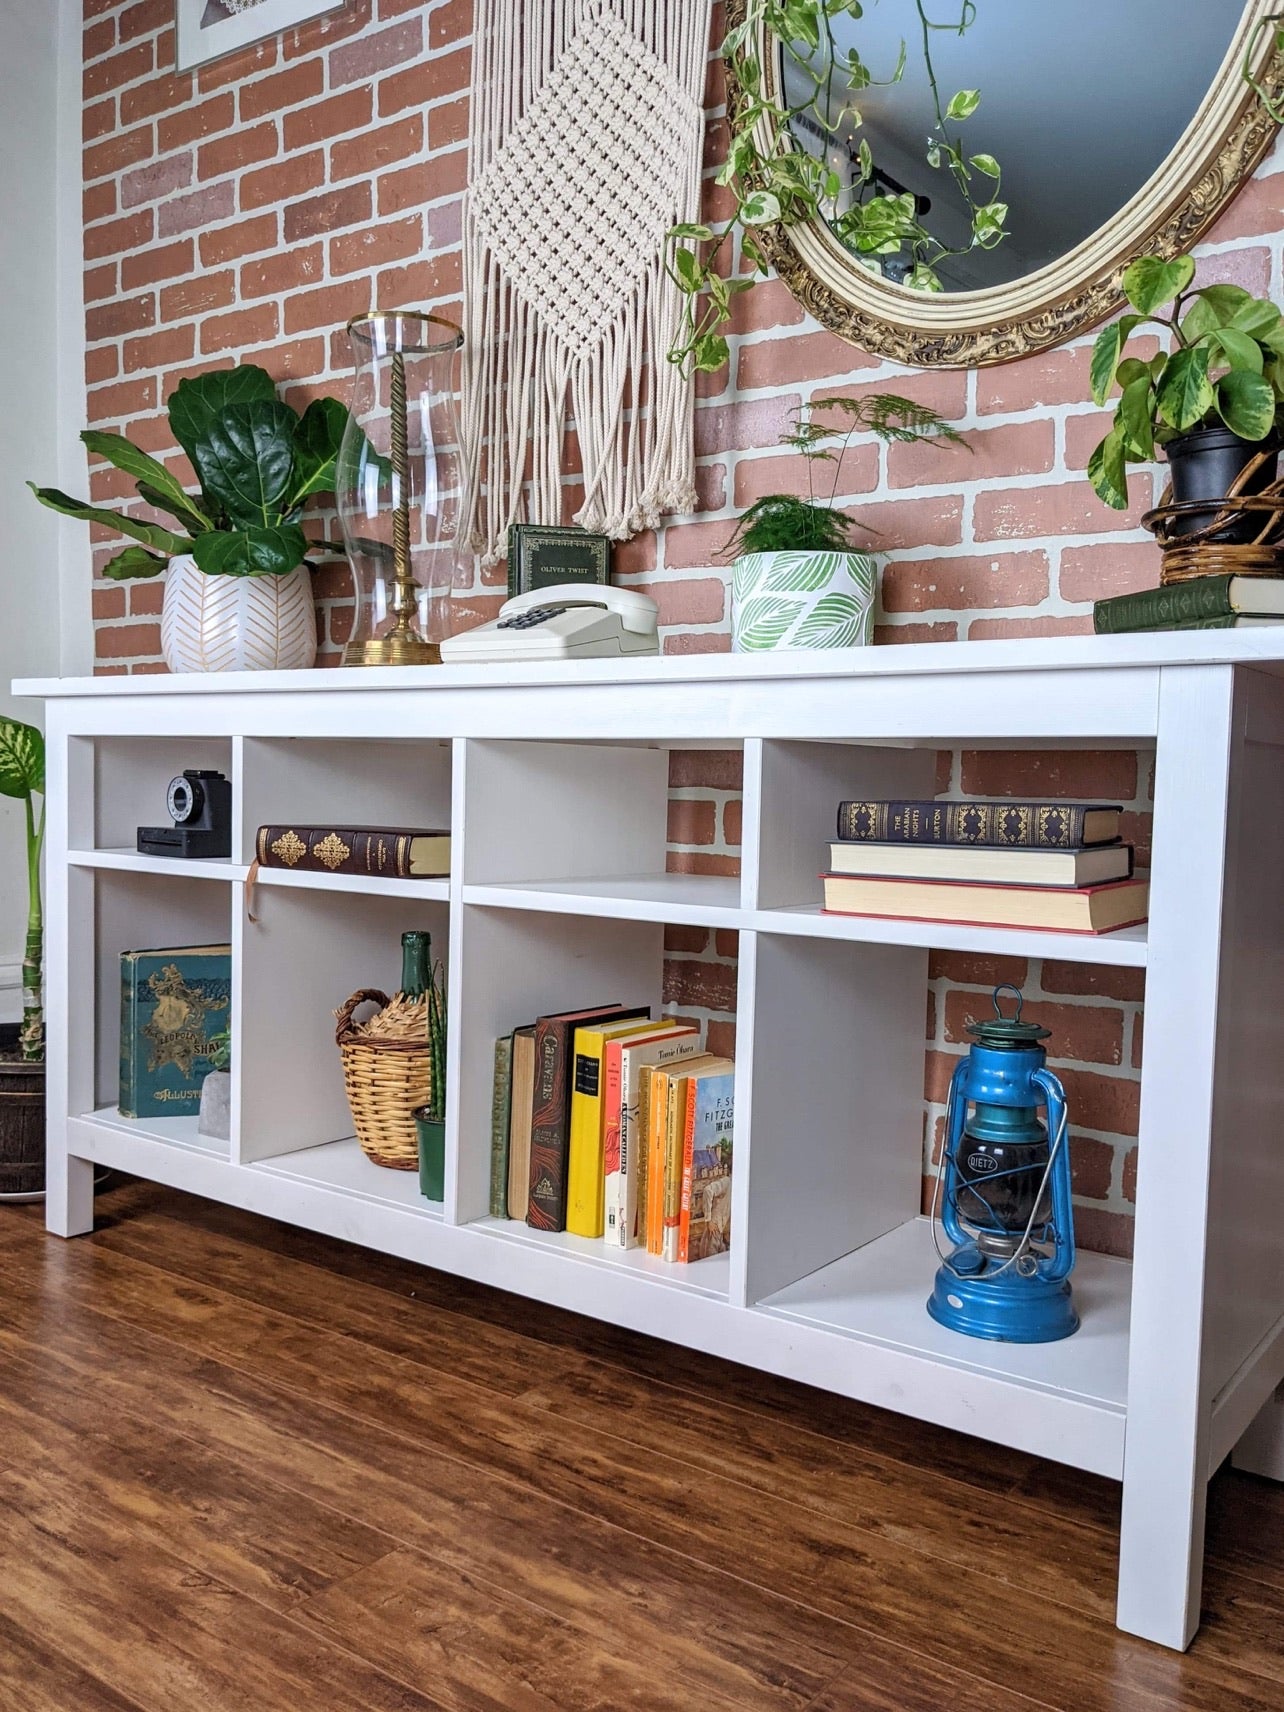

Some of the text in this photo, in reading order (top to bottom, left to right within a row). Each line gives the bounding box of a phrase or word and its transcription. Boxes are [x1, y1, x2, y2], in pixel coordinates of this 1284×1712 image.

[542, 1035, 558, 1100] Caravans
[688, 1092, 696, 1119] SCOTT
[716, 1098, 722, 1108] F.
[685, 1120, 694, 1165] FITZGERALD
[970, 1156, 994, 1169] DIETZ
